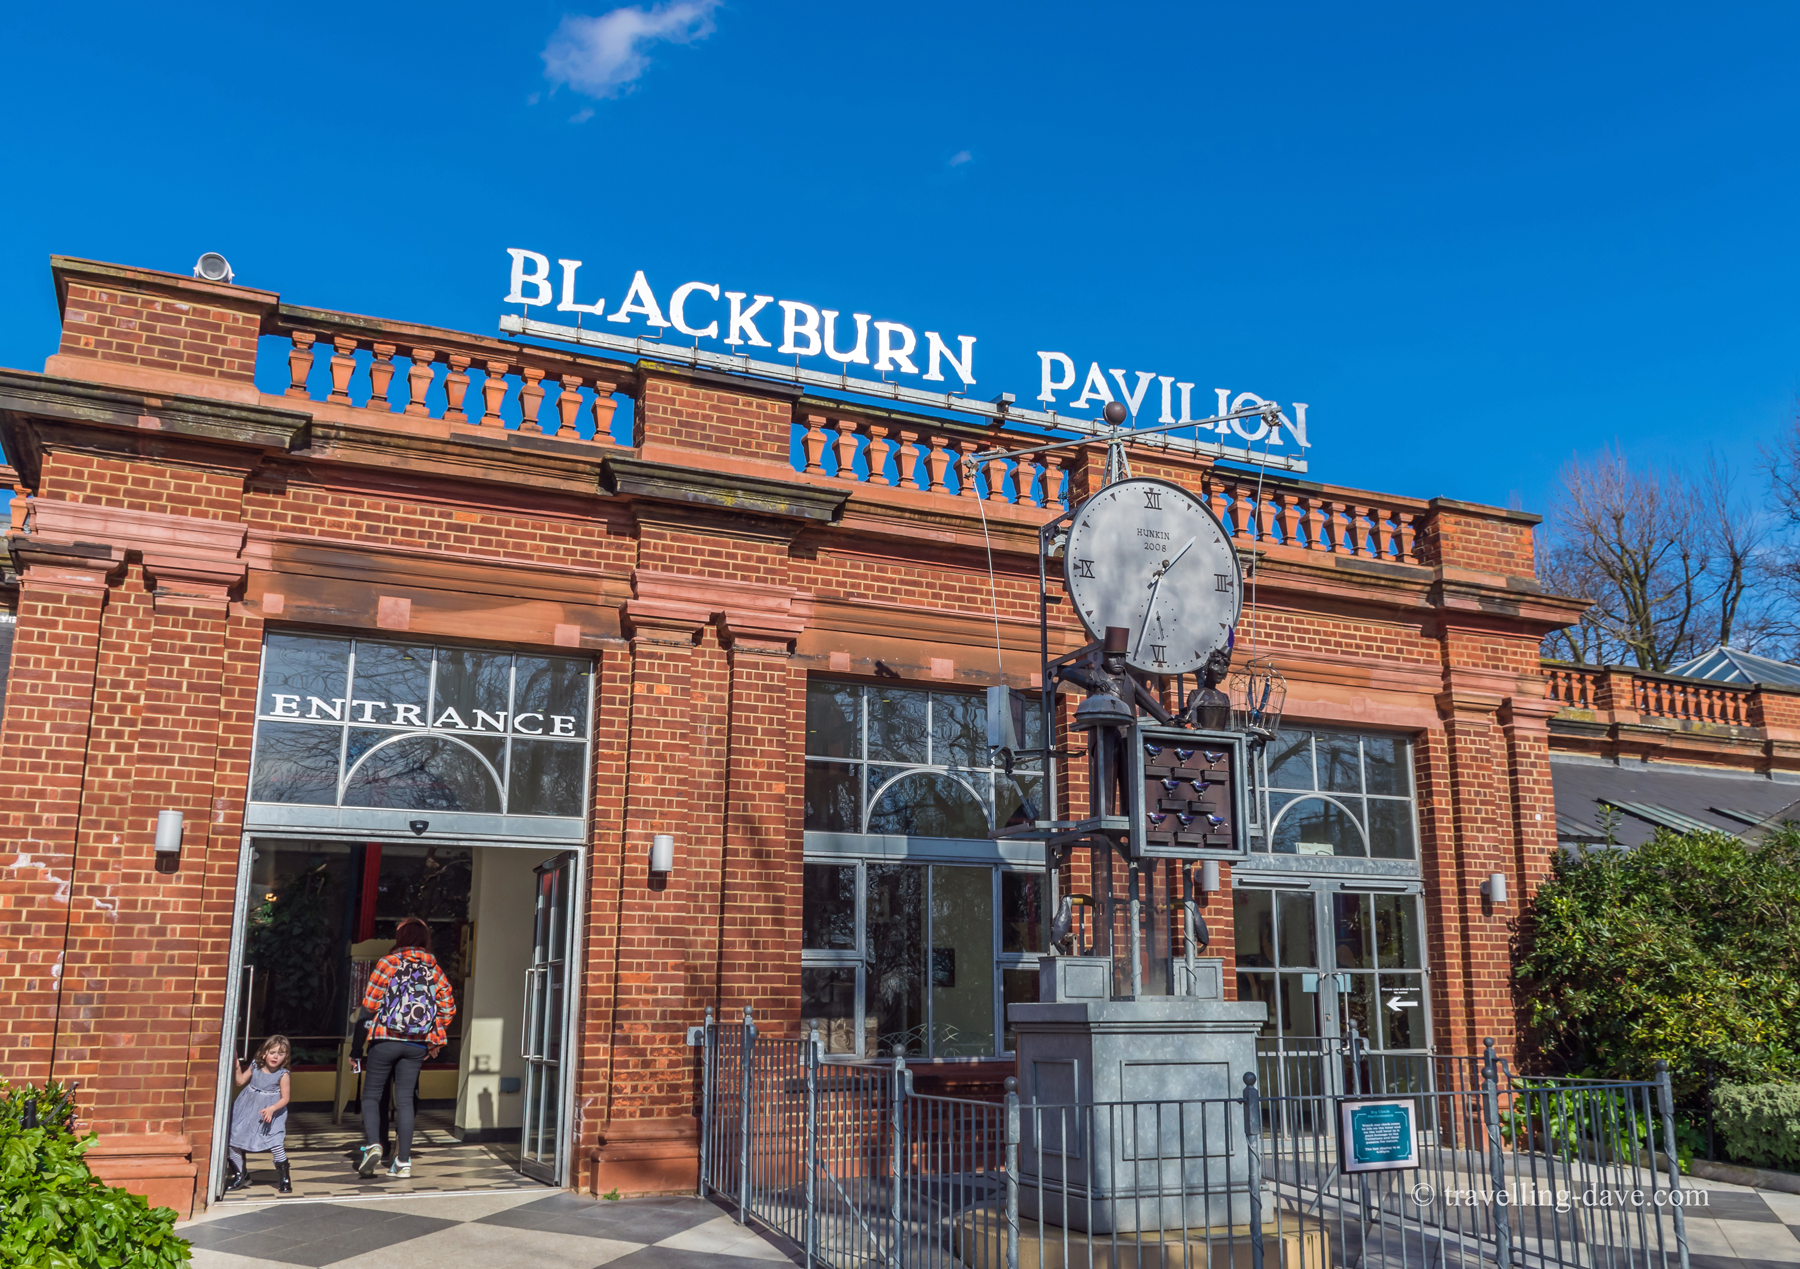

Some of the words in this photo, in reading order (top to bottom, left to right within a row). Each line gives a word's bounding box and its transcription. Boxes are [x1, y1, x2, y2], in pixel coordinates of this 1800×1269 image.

[503, 247, 977, 385] BLACKBURN
[1036, 351, 1312, 448] PAVILION
[1143, 491, 1162, 511] XII
[1136, 528, 1170, 541] HUNKIN
[1144, 542, 1167, 552] 2008
[1078, 559, 1096, 579] IX
[1213, 573, 1229, 593] III
[1150, 644, 1167, 663] VI
[269, 693, 576, 737] ENTRANCE
